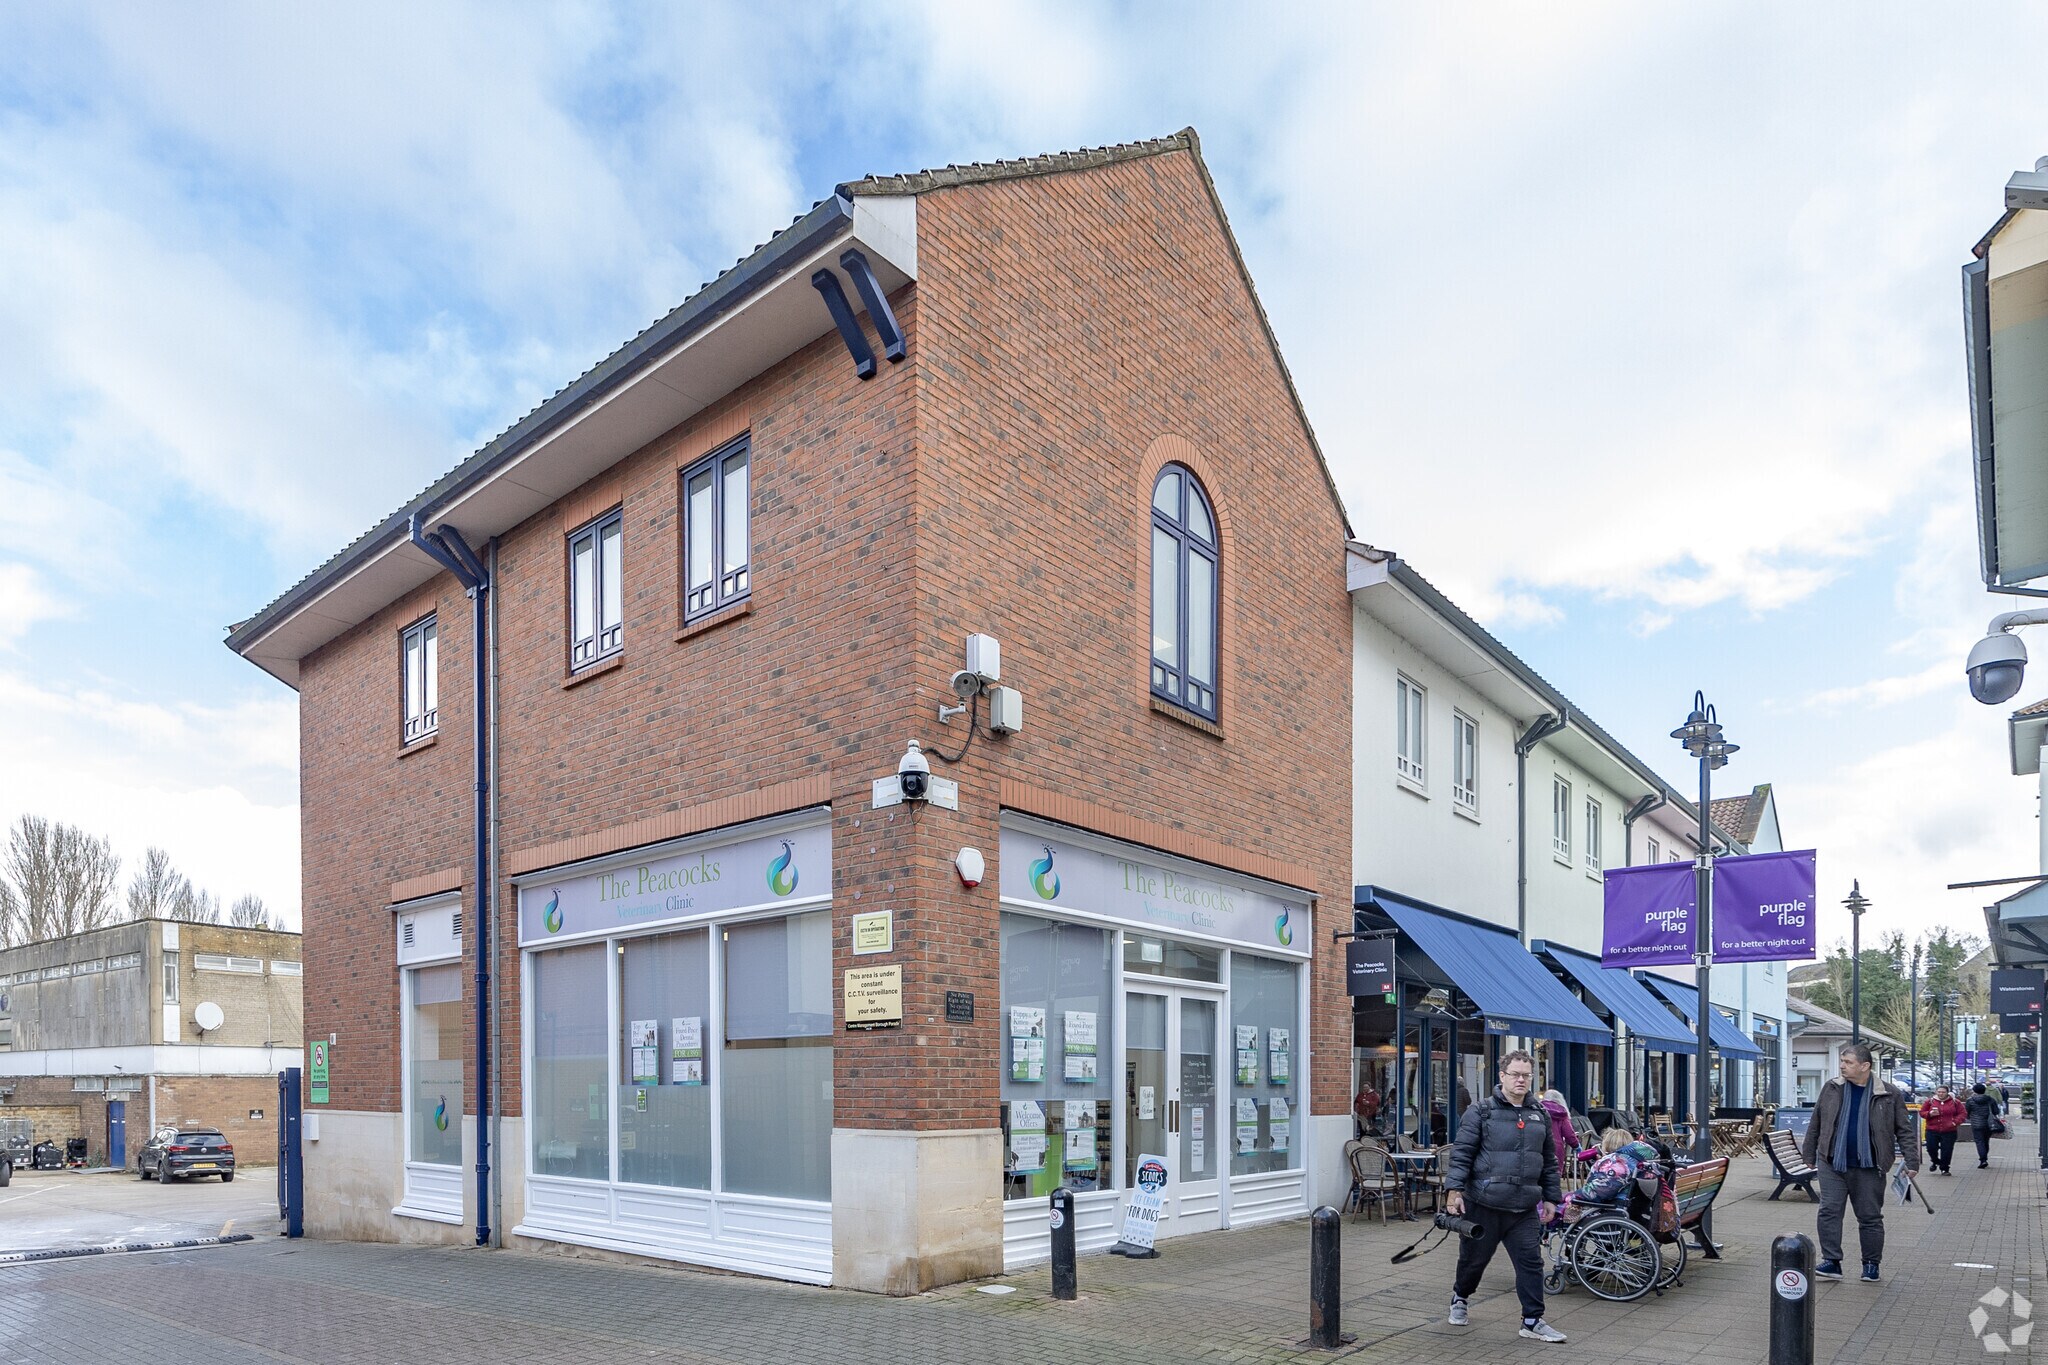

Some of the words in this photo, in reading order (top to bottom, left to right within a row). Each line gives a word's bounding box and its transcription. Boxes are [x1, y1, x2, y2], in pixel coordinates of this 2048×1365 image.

[597, 873, 631, 902] The
[637, 855, 721, 895] Peacocks
[1118, 861, 1156, 896] The
[1163, 872, 1234, 913] Peacocks
[617, 901, 663, 919] Veterinary
[666, 894, 694, 911] Clinic
[1760, 899, 1806, 917] purple
[1144, 901, 1190, 923] Veterinary
[1191, 911, 1216, 929] Clinic
[1645, 907, 1688, 923] purple
[1777, 913, 1805, 927] flag
[1661, 920, 1687, 934] flag
[1610, 946, 1621, 954] for
[1652, 944, 1672, 953] night
[1741, 940, 1766, 948] better
[1767, 939, 1789, 947] night
[861, 980, 883, 988] constant
[1015, 1111, 1041, 1120] Welcome
[1020, 1119, 1038, 1128] Offers
[1128, 1205, 1141, 1219] FOR
[1141, 1208, 1160, 1222] DOGS
